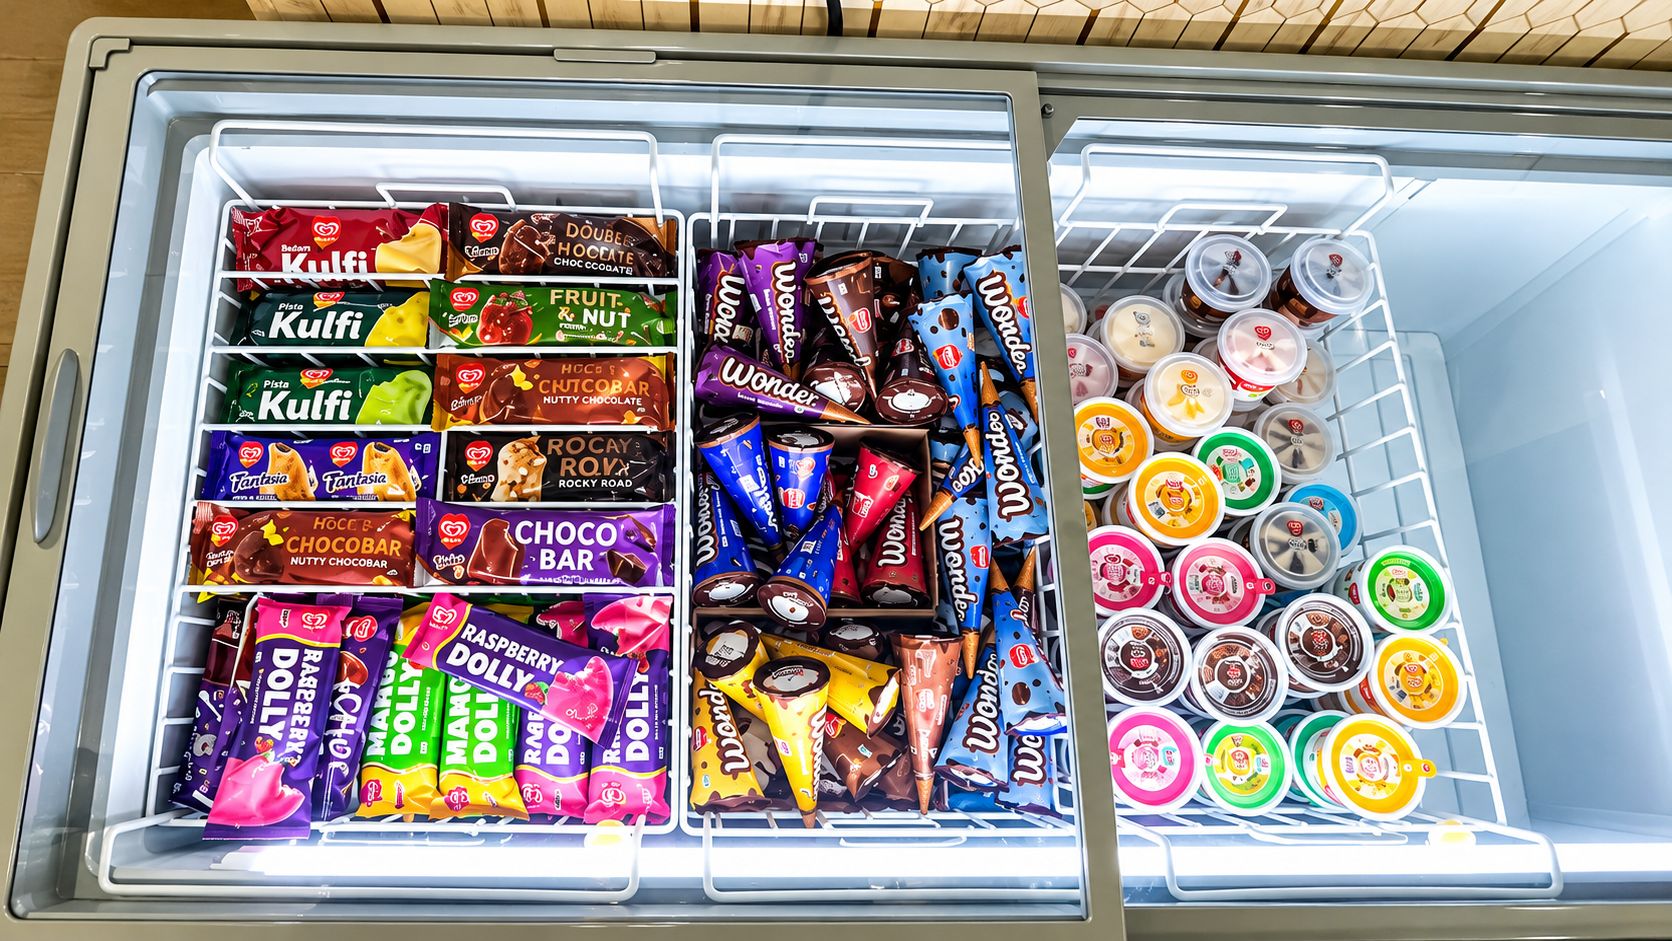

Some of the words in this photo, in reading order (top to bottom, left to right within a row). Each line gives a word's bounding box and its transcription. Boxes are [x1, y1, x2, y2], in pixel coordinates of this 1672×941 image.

[281, 250, 368, 282] Kulfi
[550, 289, 622, 309] FRUIT
[269, 311, 364, 340] Kulfi
[583, 309, 631, 328] NUT
[263, 379, 290, 389] Pista
[258, 389, 354, 421] Kulfi
[543, 395, 579, 404] NUTTY
[582, 395, 642, 406] CHOCOLATE
[230, 470, 291, 493] Fantasia
[323, 470, 388, 493] Fantasia
[558, 479, 598, 488] ROCKY
[601, 479, 633, 488] ROAD
[286, 536, 402, 557] CHOCOBAR
[515, 520, 618, 548] CHOCO
[290, 557, 327, 567] NUTTY
[329, 558, 388, 569] CHOCOBAR
[539, 549, 594, 572] BAR
[461, 623, 565, 676] RASPBERRY
[446, 642, 535, 693] DOLLY
[259, 648, 300, 741] DOLLY
[391, 659, 423, 756] DOLLY
[625, 672, 650, 762] DOLLY
